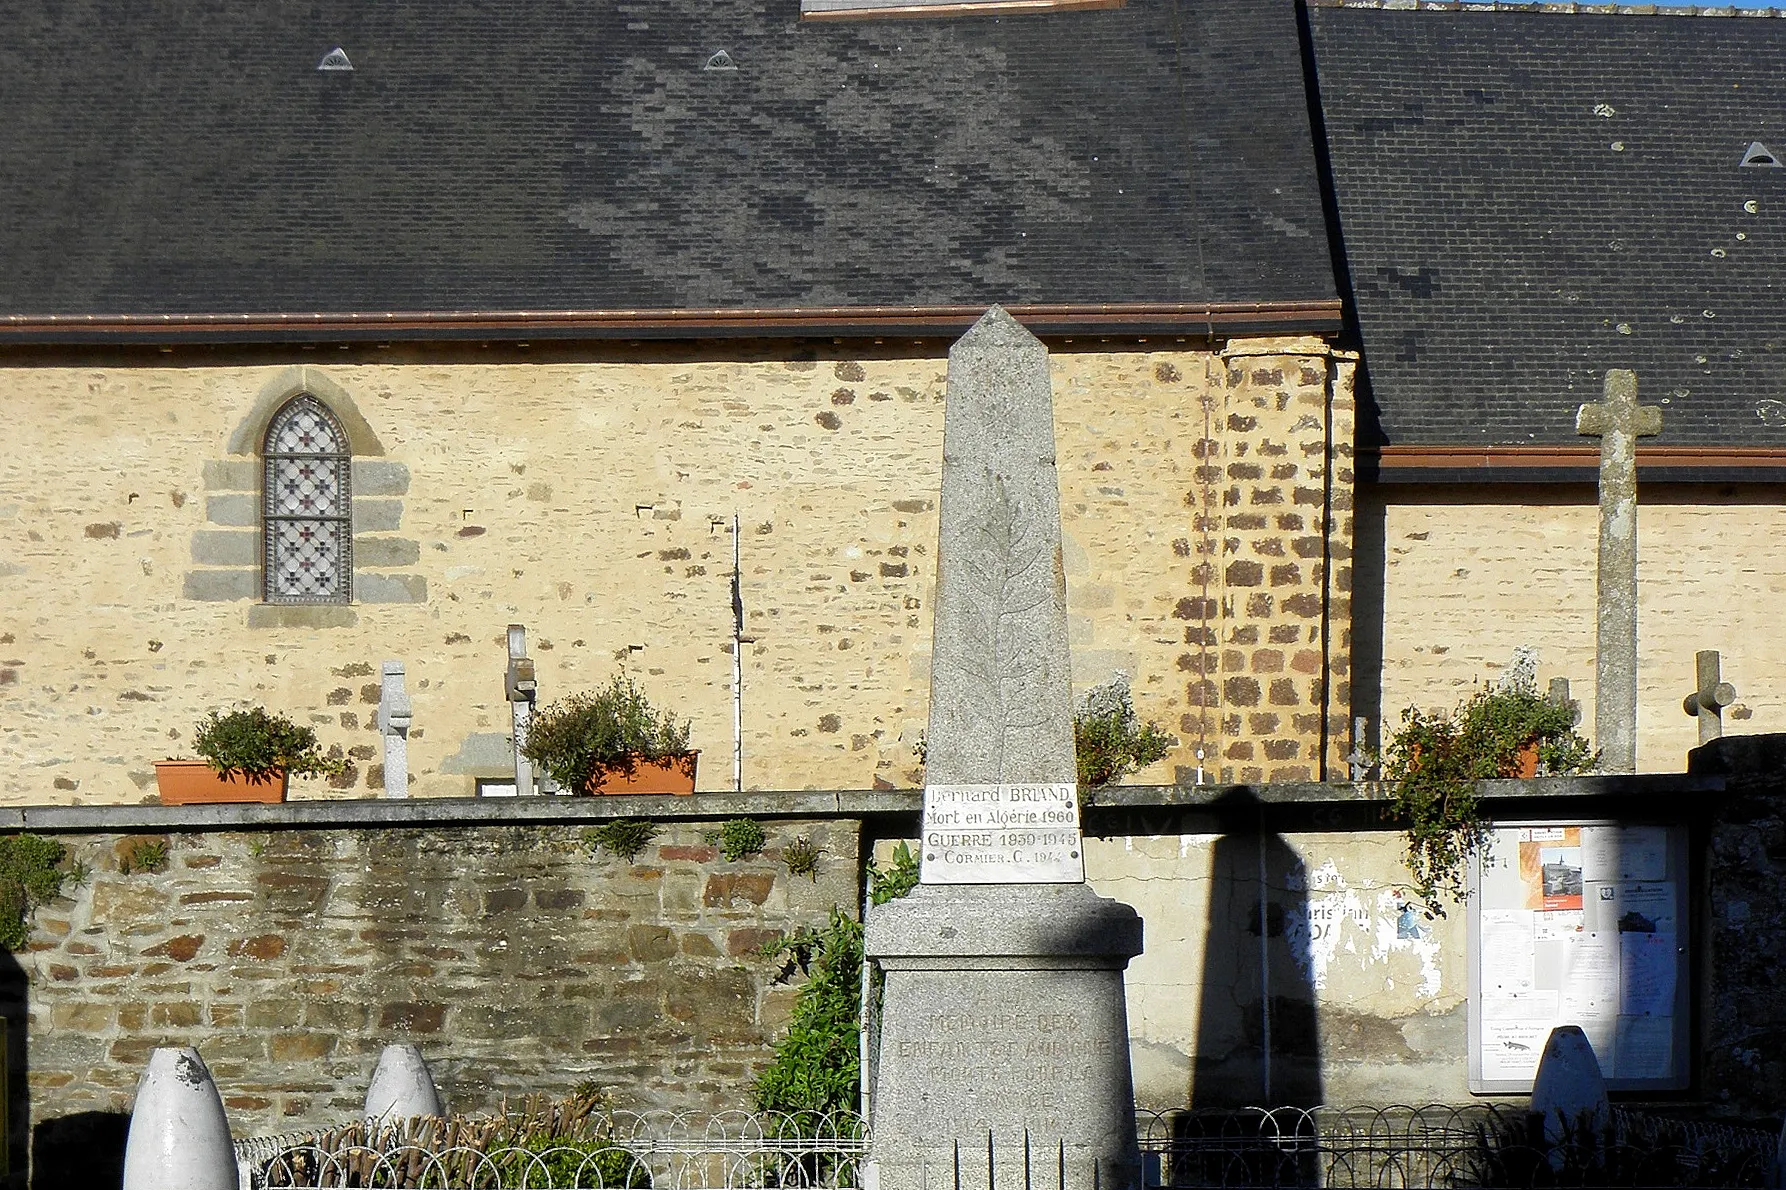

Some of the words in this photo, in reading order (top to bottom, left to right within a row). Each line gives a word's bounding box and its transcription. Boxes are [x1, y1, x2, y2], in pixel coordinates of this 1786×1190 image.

[1010, 788, 1070, 802] BRIAND
[927, 810, 960, 825] Mort
[966, 813, 982, 824] en
[987, 809, 1037, 829] Algérie
[1041, 811, 1074, 823] 1960
[928, 832, 992, 847] GUERRE
